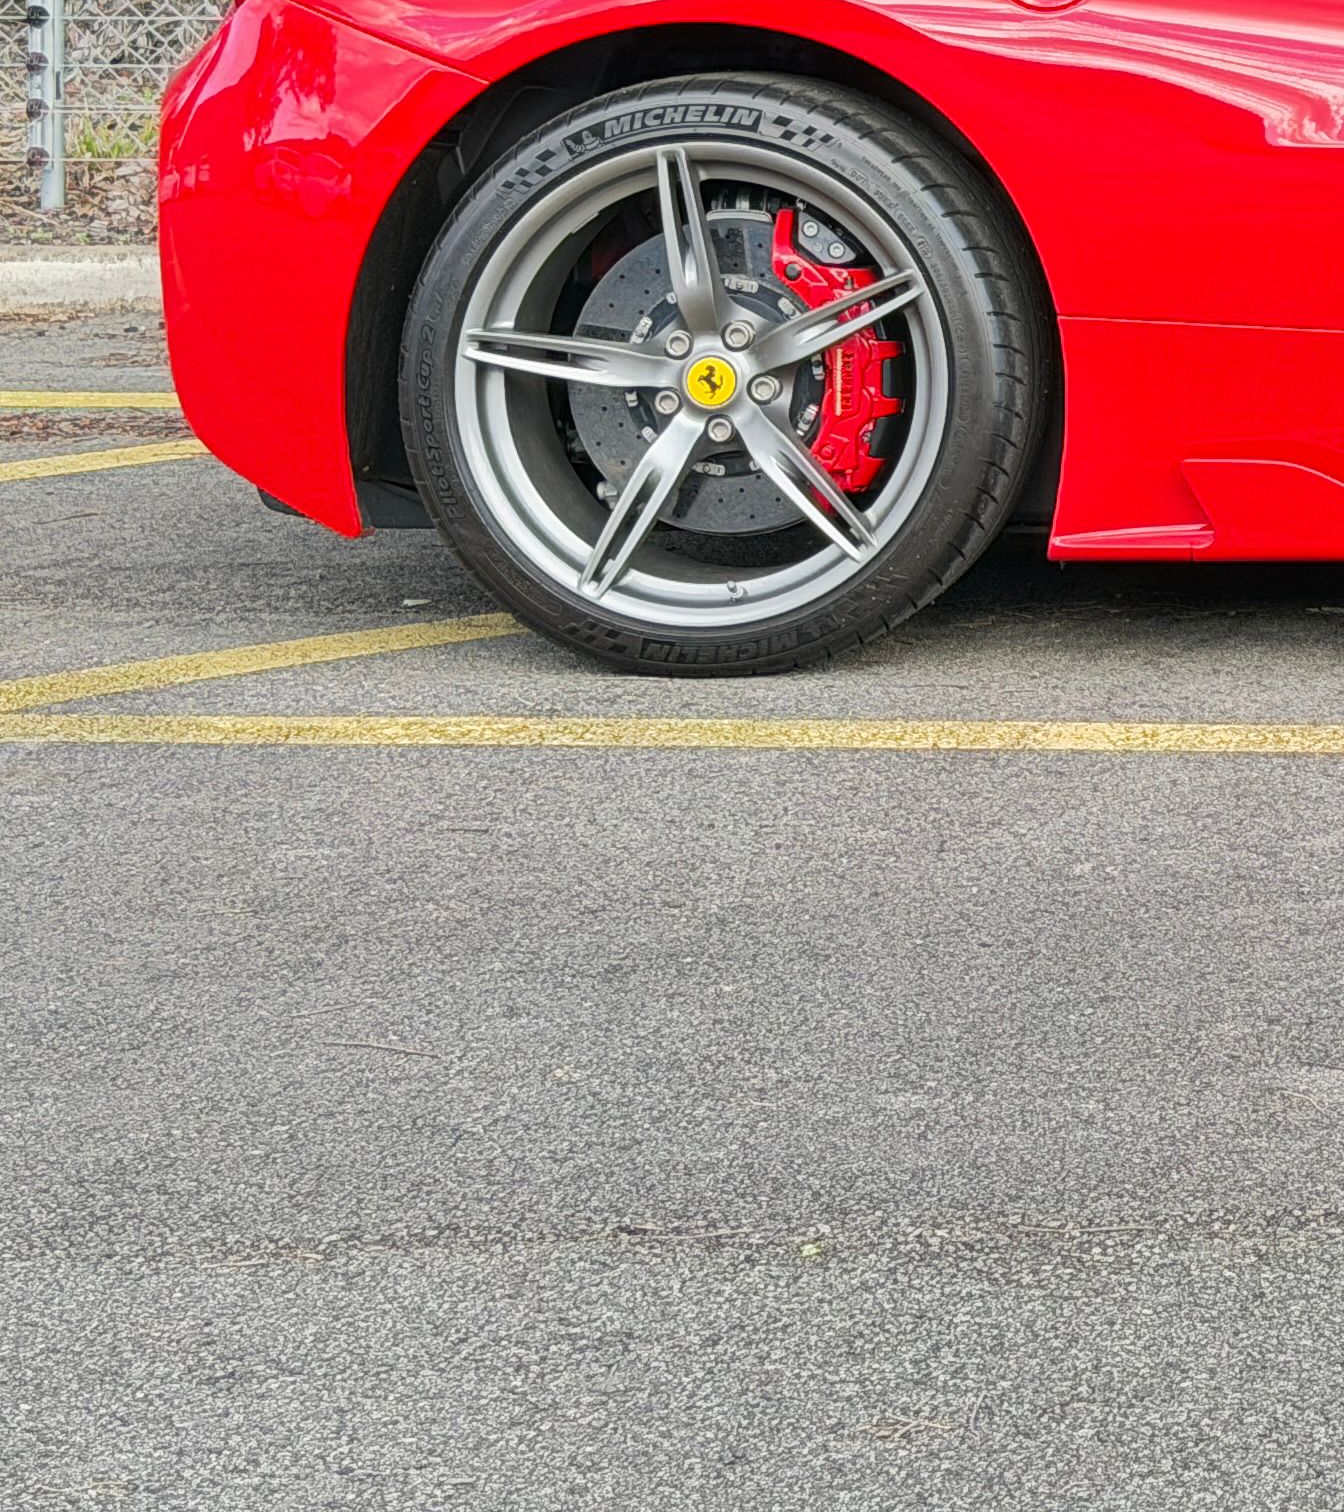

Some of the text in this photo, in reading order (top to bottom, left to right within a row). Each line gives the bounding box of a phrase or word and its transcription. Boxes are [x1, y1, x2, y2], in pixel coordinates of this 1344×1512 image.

[604, 105, 760, 138] MICHELIN
[416, 324, 465, 520] Pilot Sport Cup 2
[643, 628, 799, 664] MICHELIN
